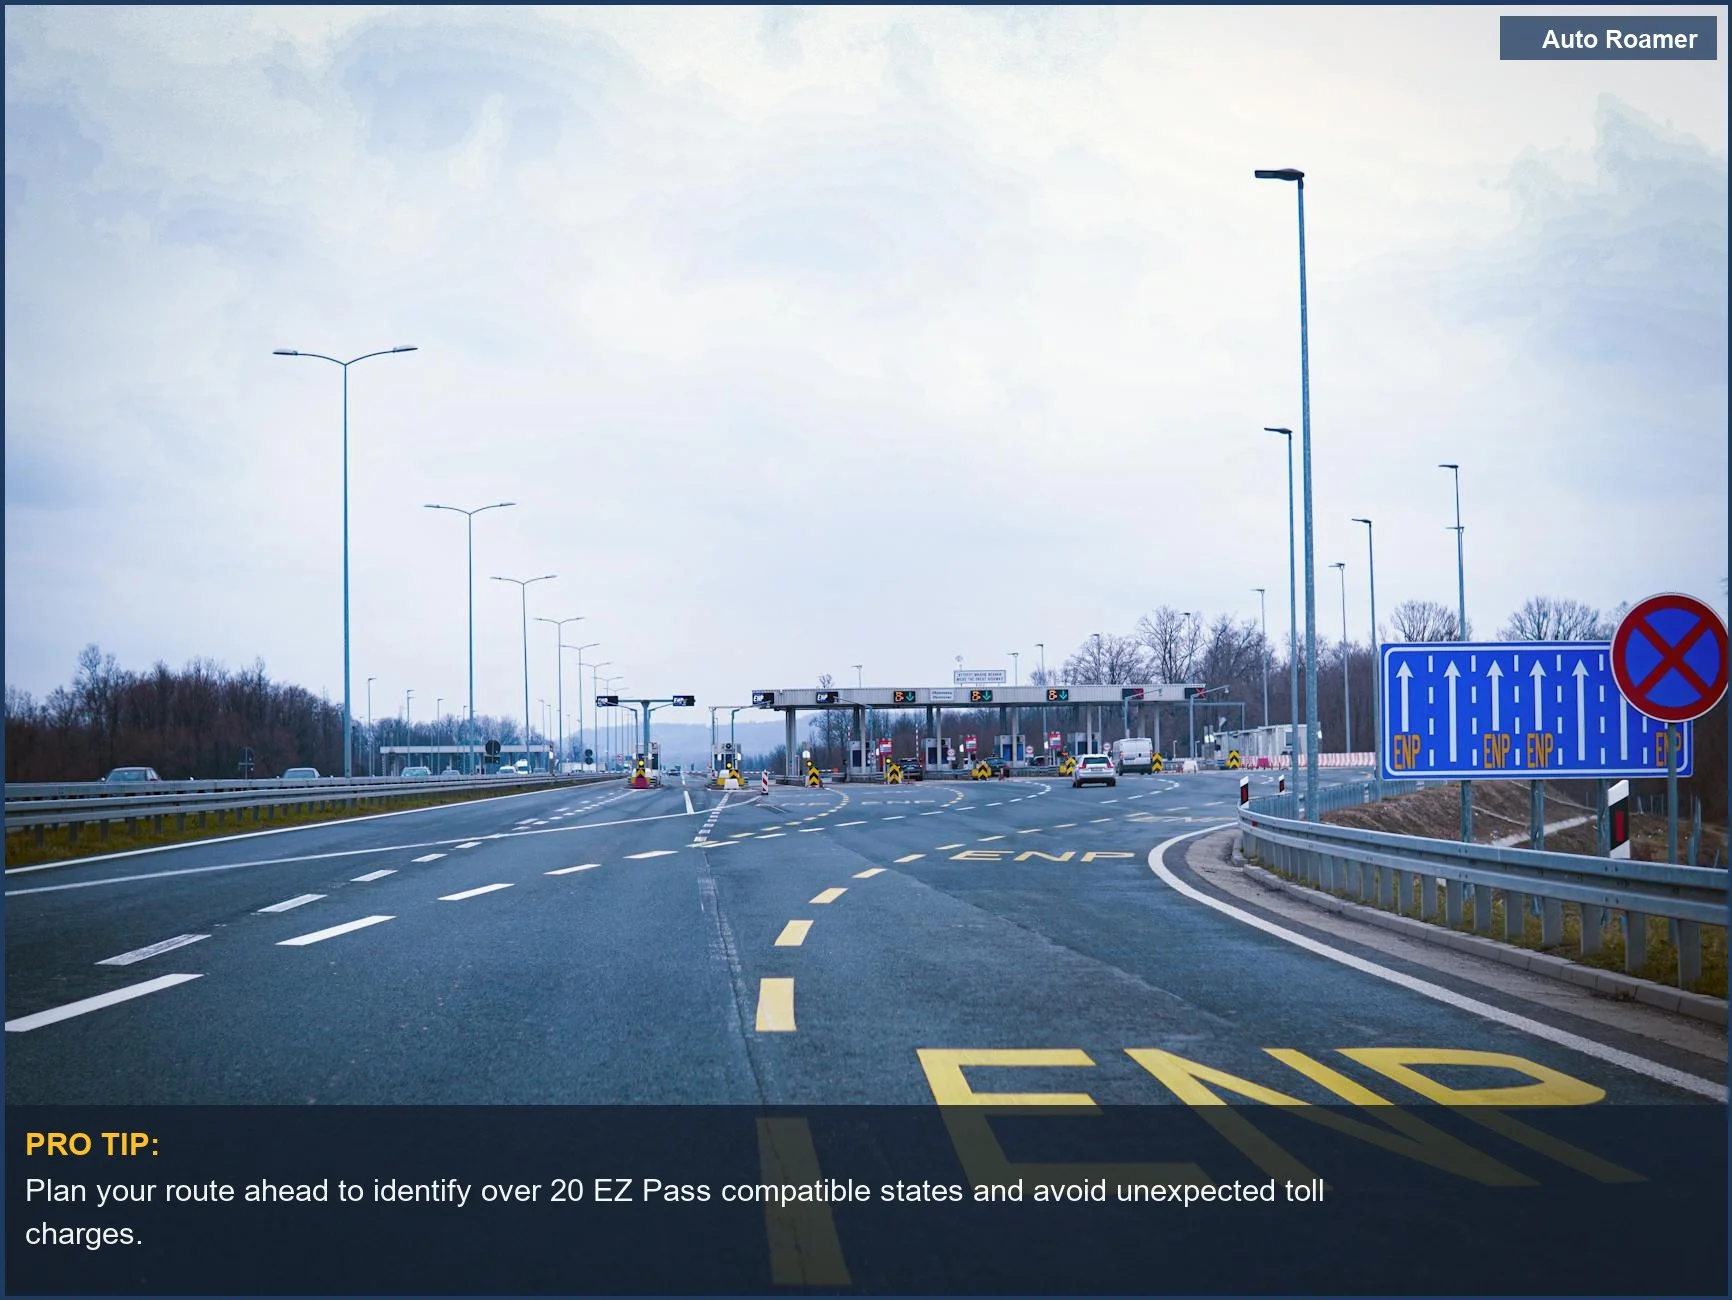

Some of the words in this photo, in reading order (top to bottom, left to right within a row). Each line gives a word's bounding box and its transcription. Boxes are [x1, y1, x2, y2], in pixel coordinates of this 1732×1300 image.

[1394, 734, 1420, 770] ENP
[1484, 733, 1510, 769] ENP
[1527, 733, 1554, 769] ENP
[949, 850, 1135, 862] ENP
[916, 1047, 1652, 1191] ENP
